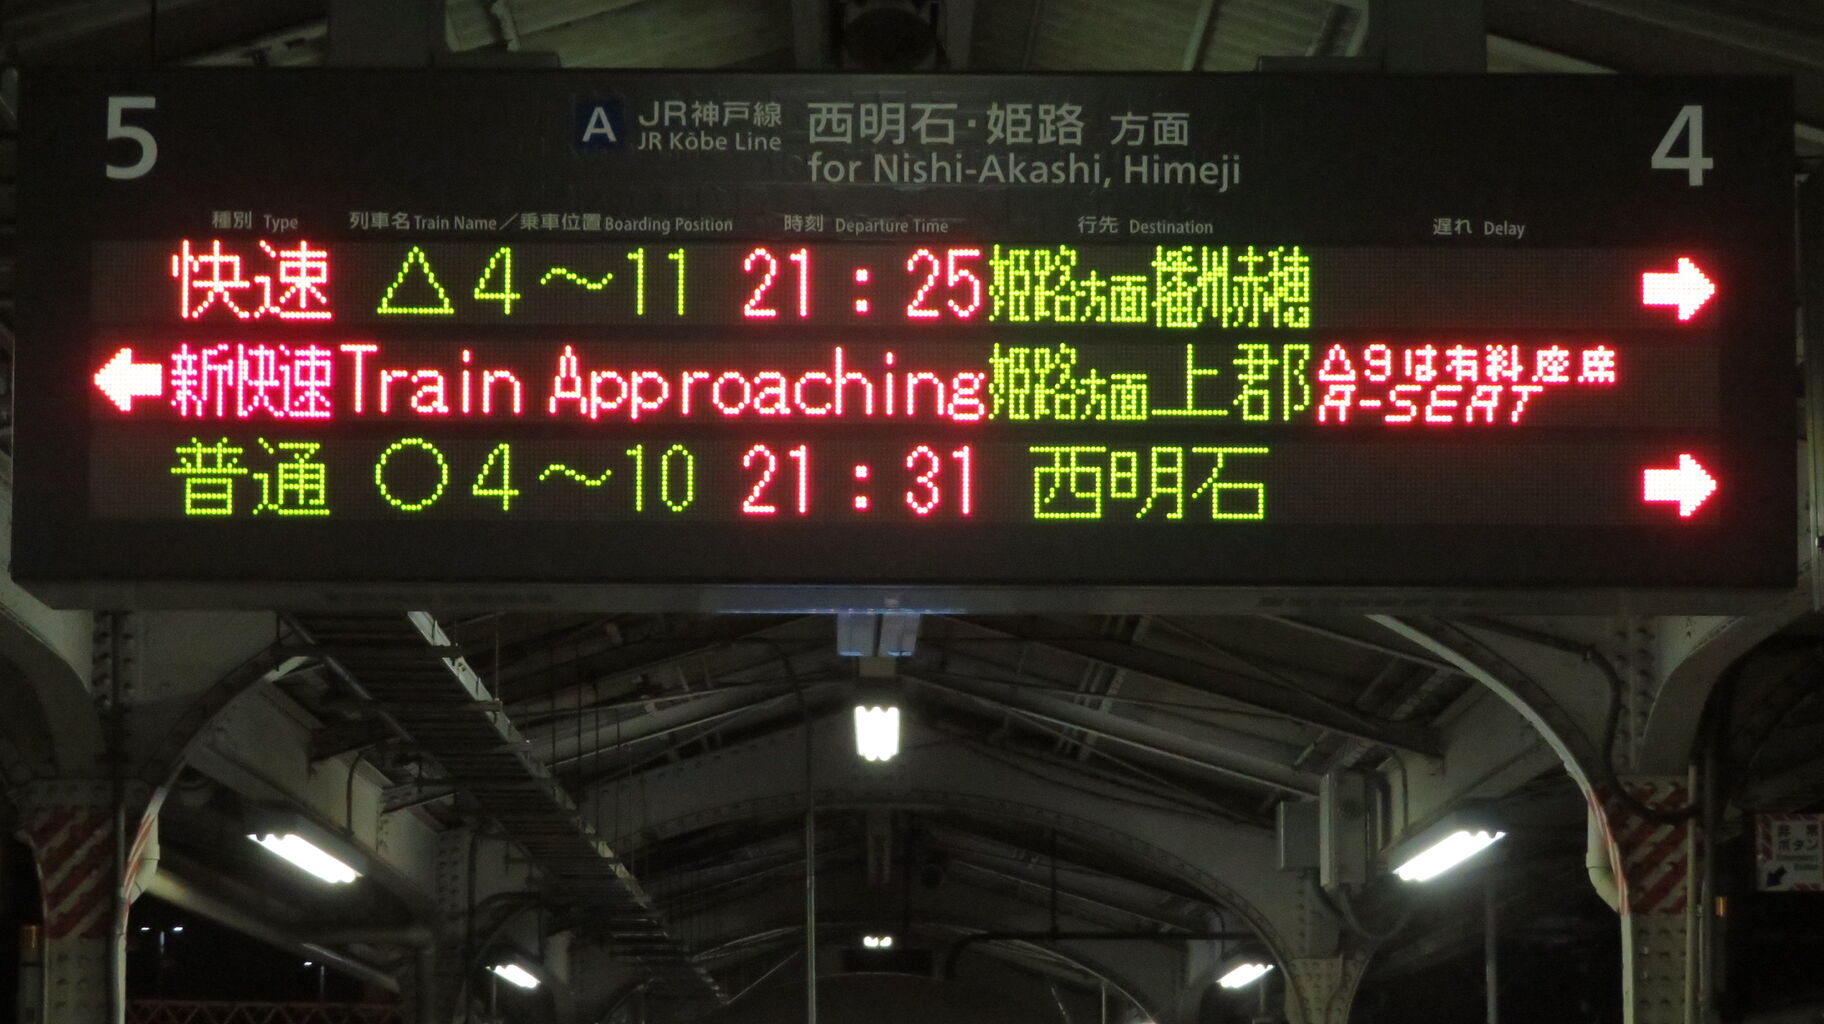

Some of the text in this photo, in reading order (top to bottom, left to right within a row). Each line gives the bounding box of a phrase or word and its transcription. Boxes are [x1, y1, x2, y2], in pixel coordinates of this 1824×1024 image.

[582, 106, 617, 142] A
[638, 100, 782, 128] JR神戸線
[1110, 111, 1190, 146] 方面
[105, 96, 158, 180] 5
[638, 130, 782, 151] JR Kōbe Line
[1651, 105, 1714, 187] 4
[807, 151, 1240, 193] for Nishi-Akashi, Himeji
[212, 210, 299, 233] 種別 Type
[349, 211, 410, 230] 列車名
[414, 215, 450, 230] Train
[454, 215, 497, 231] Name
[605, 216, 671, 236] Boarding
[675, 217, 733, 232] Position
[784, 214, 949, 236] 時刻 Departure Time
[1077, 215, 1213, 234] 行先 Destination
[1432, 217, 1525, 240] 遅れ Delay
[171, 239, 333, 320] 快速
[170, 343, 331, 419] 新快速
[339, 343, 525, 415] Train
[548, 344, 986, 422] Approaching
[170, 437, 330, 516] 普通
[1029, 445, 1269, 520] 西明石
